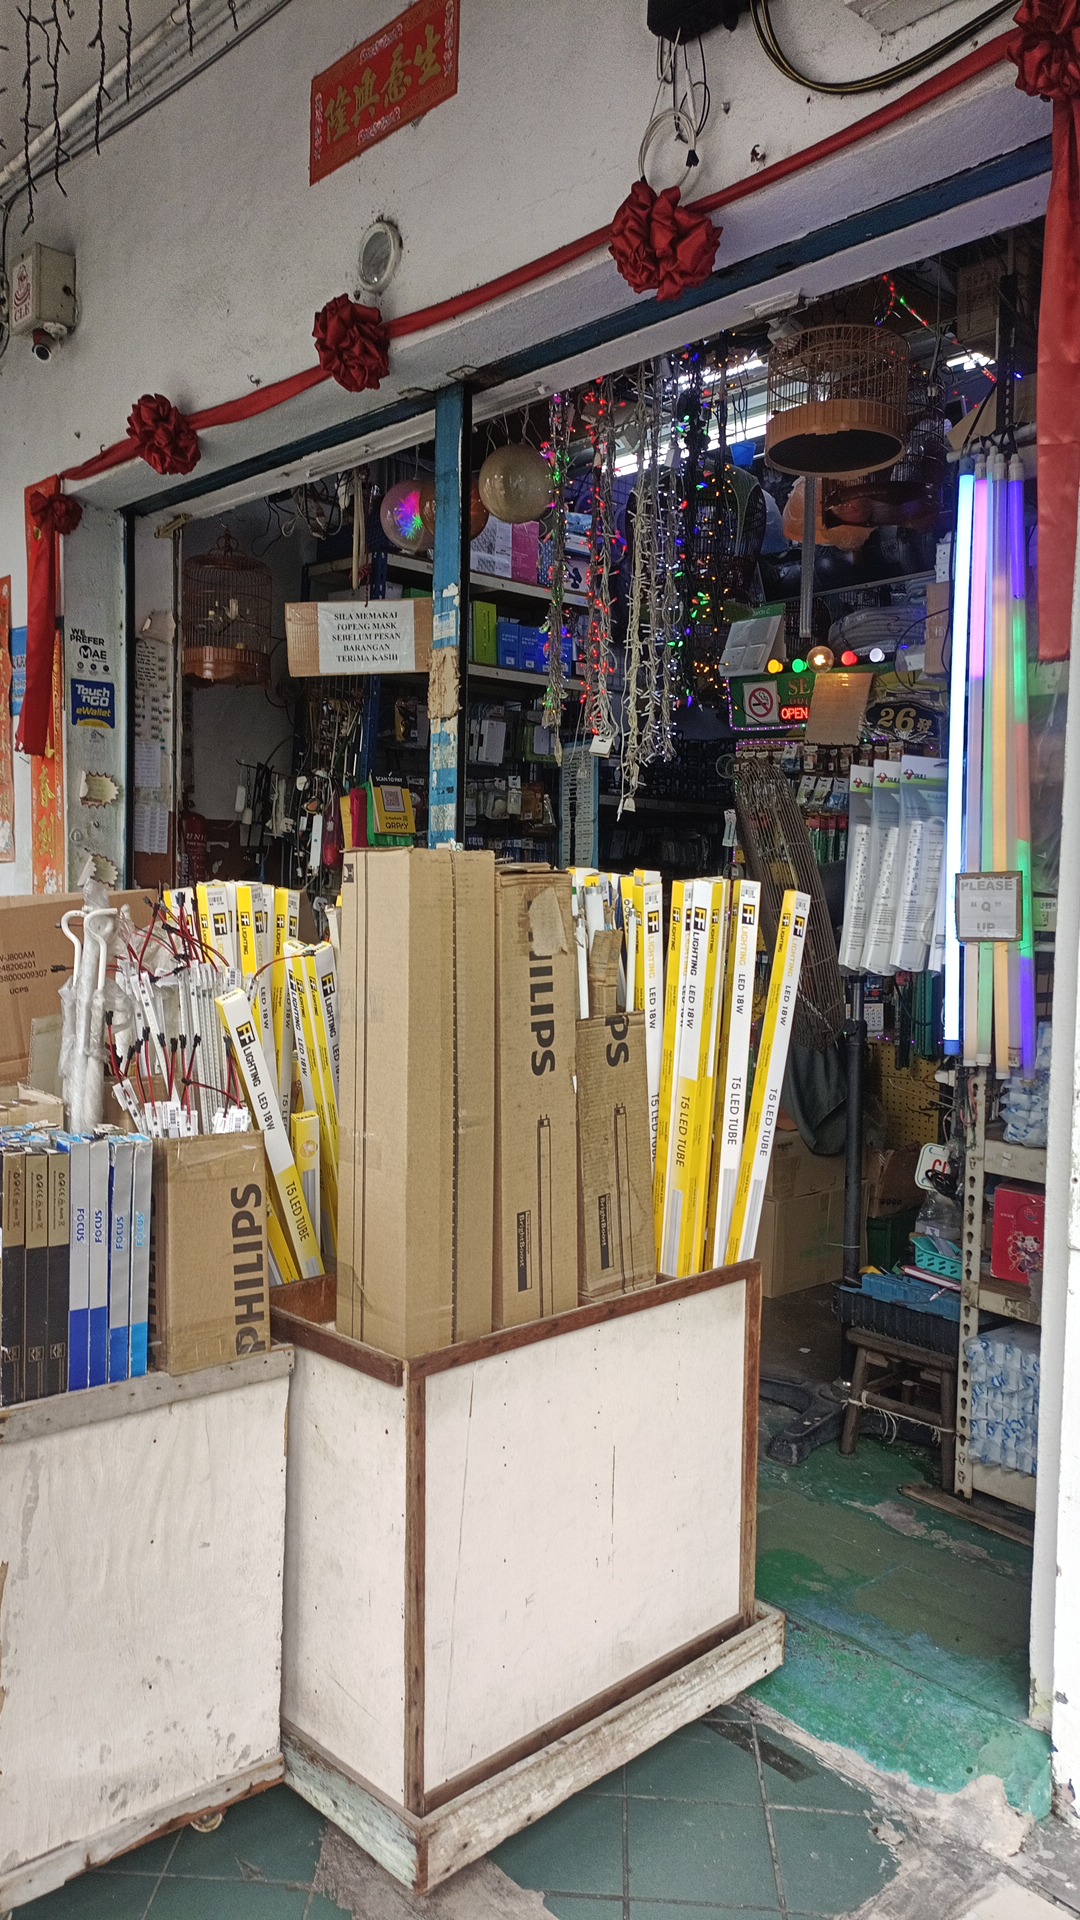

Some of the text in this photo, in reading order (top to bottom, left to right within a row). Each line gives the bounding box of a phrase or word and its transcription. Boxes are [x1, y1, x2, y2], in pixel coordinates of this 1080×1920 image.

[334, 611, 398, 620] SILA MEMAKAI
[337, 621, 397, 631] TOPENG MASK
[70, 634, 105, 646] PREFER
[79, 644, 107, 660] MAE
[331, 632, 401, 641] SEBELUM PESAN
[343, 643, 390, 652] BARANGAN
[336, 653, 398, 662] TERIMA KASIH
[75, 683, 110, 698] Touch
[75, 706, 111, 718] eWallet
[781, 707, 808, 719] OPEN
[877, 707, 916, 732] 26
[961, 880, 1013, 891] PLEASE
[241, 927, 249, 955] LIGHTING
[276, 929, 284, 956] LIGHTING
[777, 926, 785, 953] LIGHTING
[977, 922, 995, 932] UP
[648, 935, 656, 979] LIGHTING
[690, 931, 700, 976] LIGHTING
[740, 926, 749, 967] LIGHTING
[787, 938, 798, 977] LIGHTING
[0, 961, 36, 972] 48206201
[10, 986, 29, 995] UCPS
[310, 992, 319, 1017] LIGHTING
[527, 901, 556, 1077] ILIPS
[736, 974, 746, 1015] LED 18W
[780, 985, 791, 1026] LED 18W
[291, 991, 300, 1031] LIGHTING
[324, 997, 337, 1038] LIGHTING
[686, 985, 697, 1030] LED 18W
[243, 1047, 261, 1088] LIGHTING
[257, 1091, 276, 1131] LED 18W
[651, 1093, 659, 1106] T5
[727, 1077, 742, 1145] T5 LED TUBE
[675, 1094, 690, 1168] T5 LED TUBE
[759, 1088, 777, 1157] T5 LED TUBE
[77, 1208, 85, 1242] FOCUS
[95, 1210, 103, 1243] FOCUS
[285, 1180, 311, 1243] T5 LED TUBE
[600, 1197, 608, 1247] BrightBoost
[116, 1216, 124, 1249] FOCUS
[136, 1213, 145, 1247] FOCUS
[230, 1183, 266, 1356] PHILIPS
